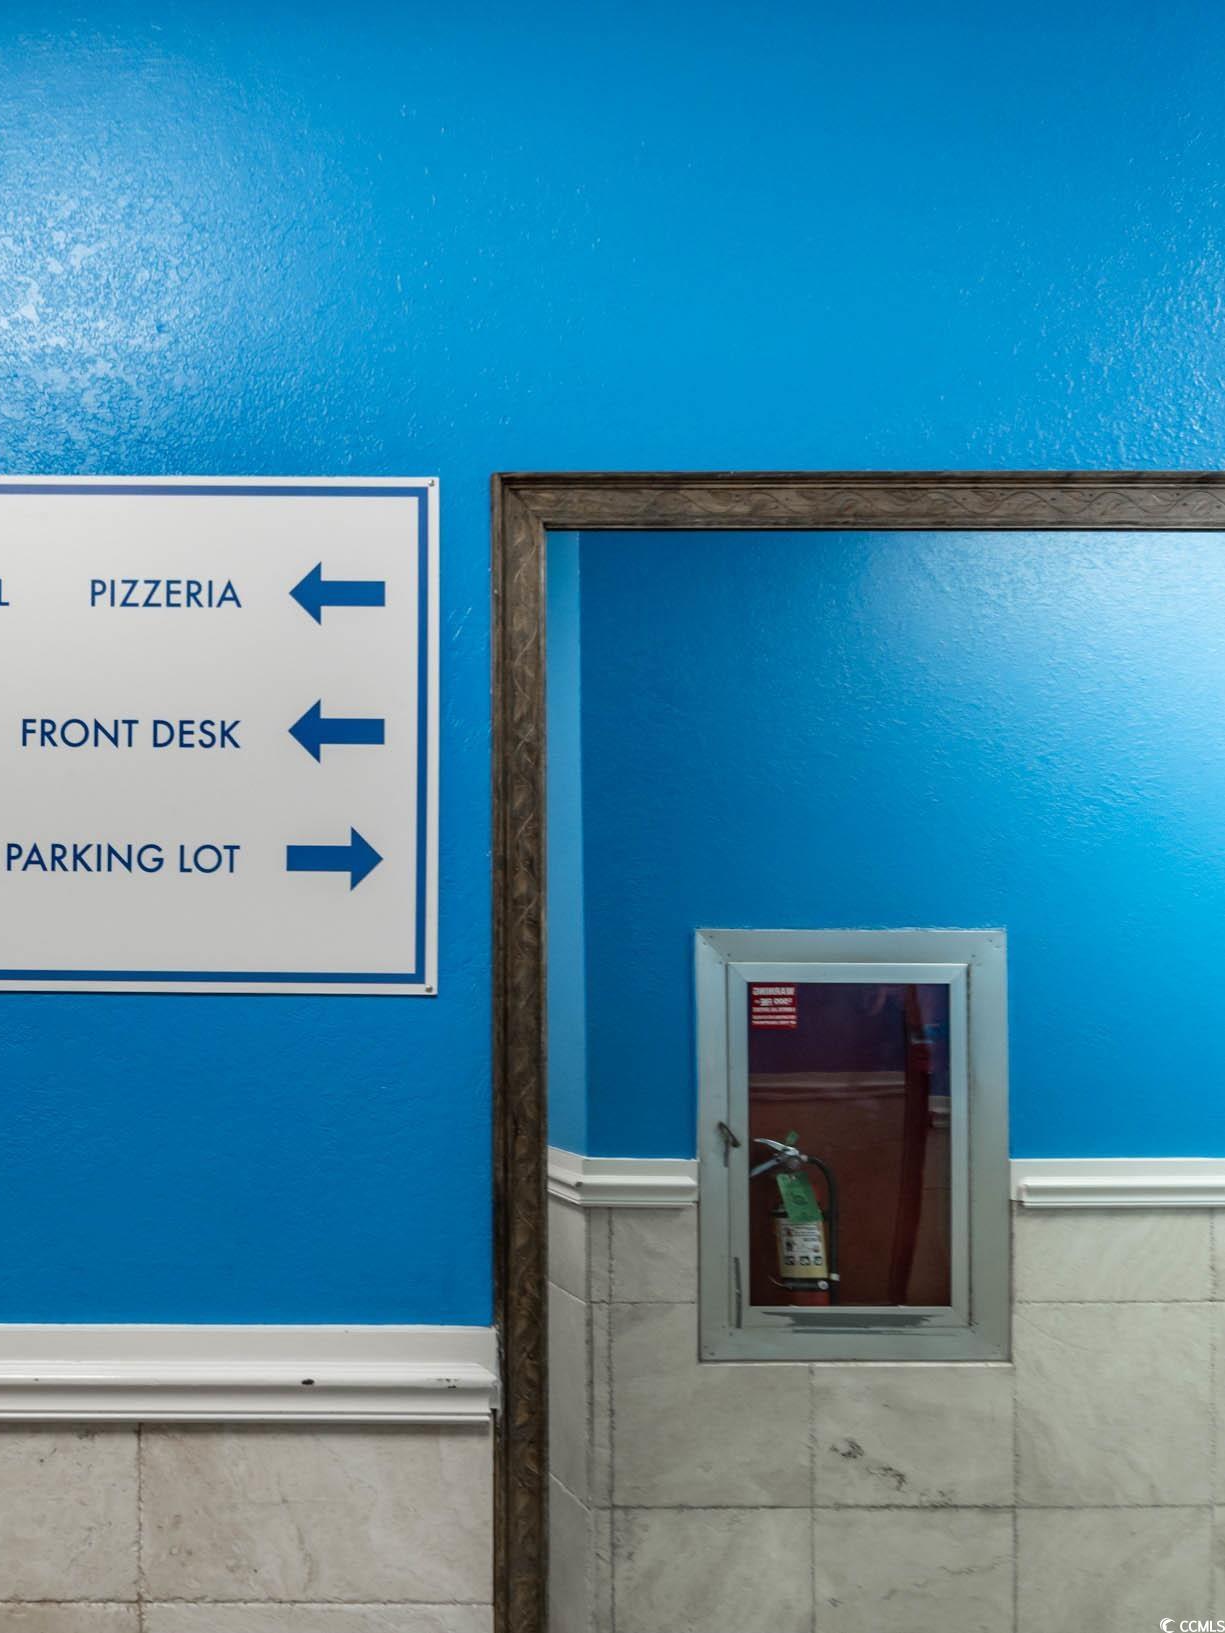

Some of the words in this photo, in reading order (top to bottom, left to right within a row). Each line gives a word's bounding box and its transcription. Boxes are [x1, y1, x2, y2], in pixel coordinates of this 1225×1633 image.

[90, 579, 242, 609] PIZZERIA
[21, 718, 140, 748] FRONT
[152, 719, 241, 749] DESK
[6, 842, 165, 873] PARKING
[179, 844, 241, 874] LOT
